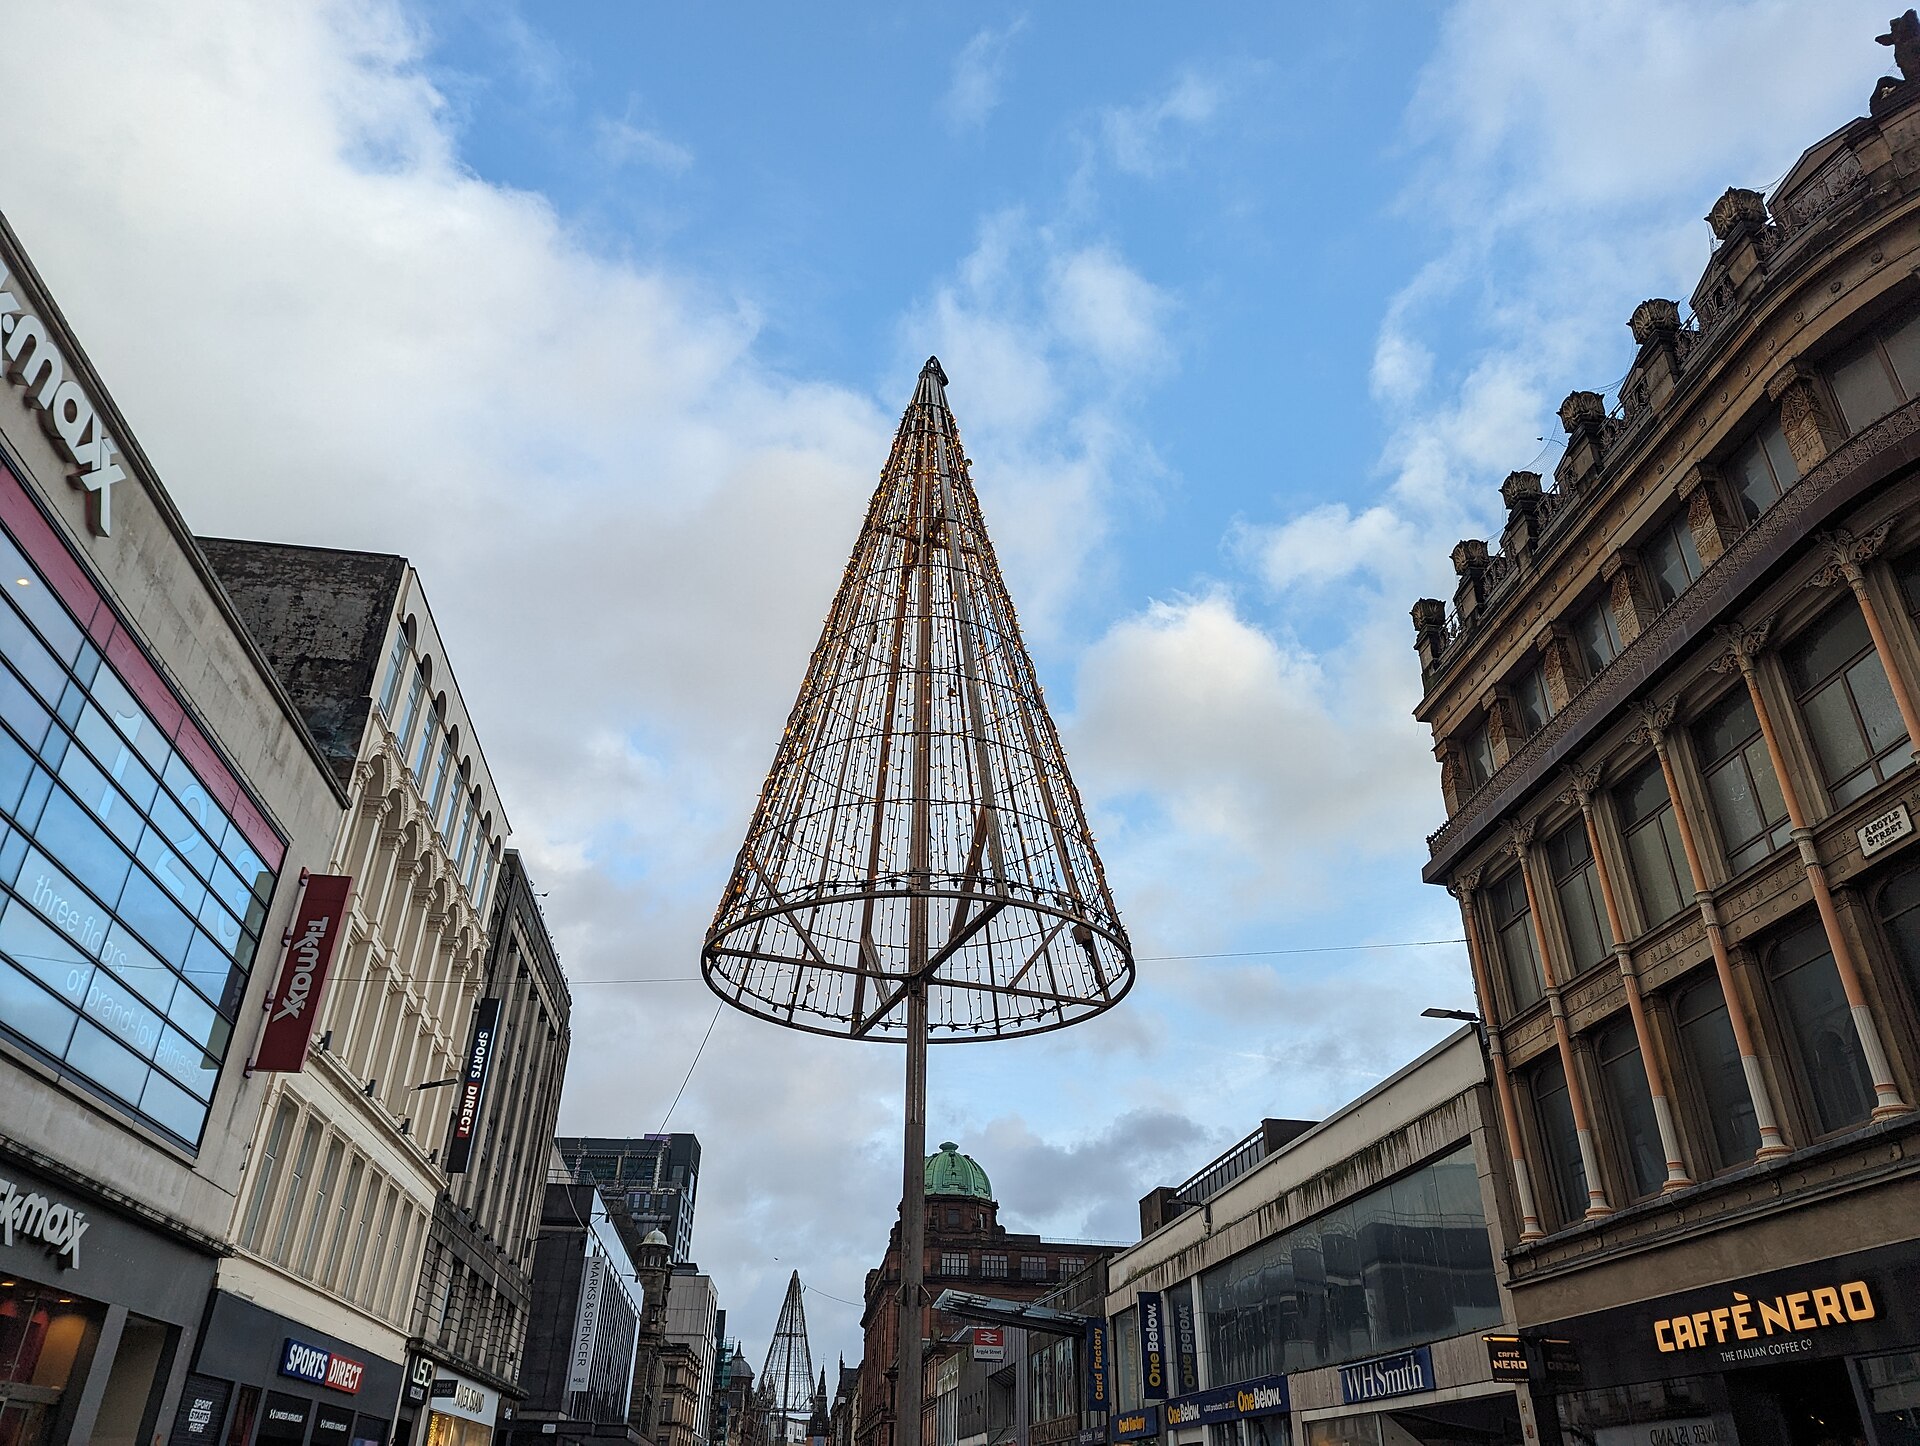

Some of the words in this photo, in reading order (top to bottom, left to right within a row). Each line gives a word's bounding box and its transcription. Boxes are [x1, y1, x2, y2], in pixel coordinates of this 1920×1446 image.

[1864, 810, 1900, 838] ARGYLE
[1866, 820, 1903, 847] STREET
[32, 873, 81, 934] three
[84, 915, 128, 975] floors
[66, 964, 91, 993] of
[470, 1031, 489, 1080] SPORTS
[459, 1085, 478, 1135] DIRECT
[586, 1261, 601, 1301] MARKS
[585, 1301, 595, 1310] &
[1653, 1291, 1759, 1353] CAFFÈ
[1757, 1280, 1876, 1336] NERO
[576, 1311, 594, 1367] SPENCER
[1093, 1328, 1104, 1370] Factory
[1720, 1350, 1736, 1363] THE
[1736, 1346, 1768, 1361] ITALIAN
[1768, 1340, 1800, 1356] COFFEE
[286, 1344, 328, 1380] SPORTS
[327, 1358, 363, 1390] DIRECT
[412, 1355, 434, 1387] USC
[1345, 1355, 1425, 1401] WHSmith
[1493, 1360, 1528, 1370] NERO
[1094, 1373, 1105, 1401] Card
[190, 1410, 210, 1423] STARTS
[193, 1398, 213, 1410] SPORT
[188, 1423, 205, 1433] HERE
